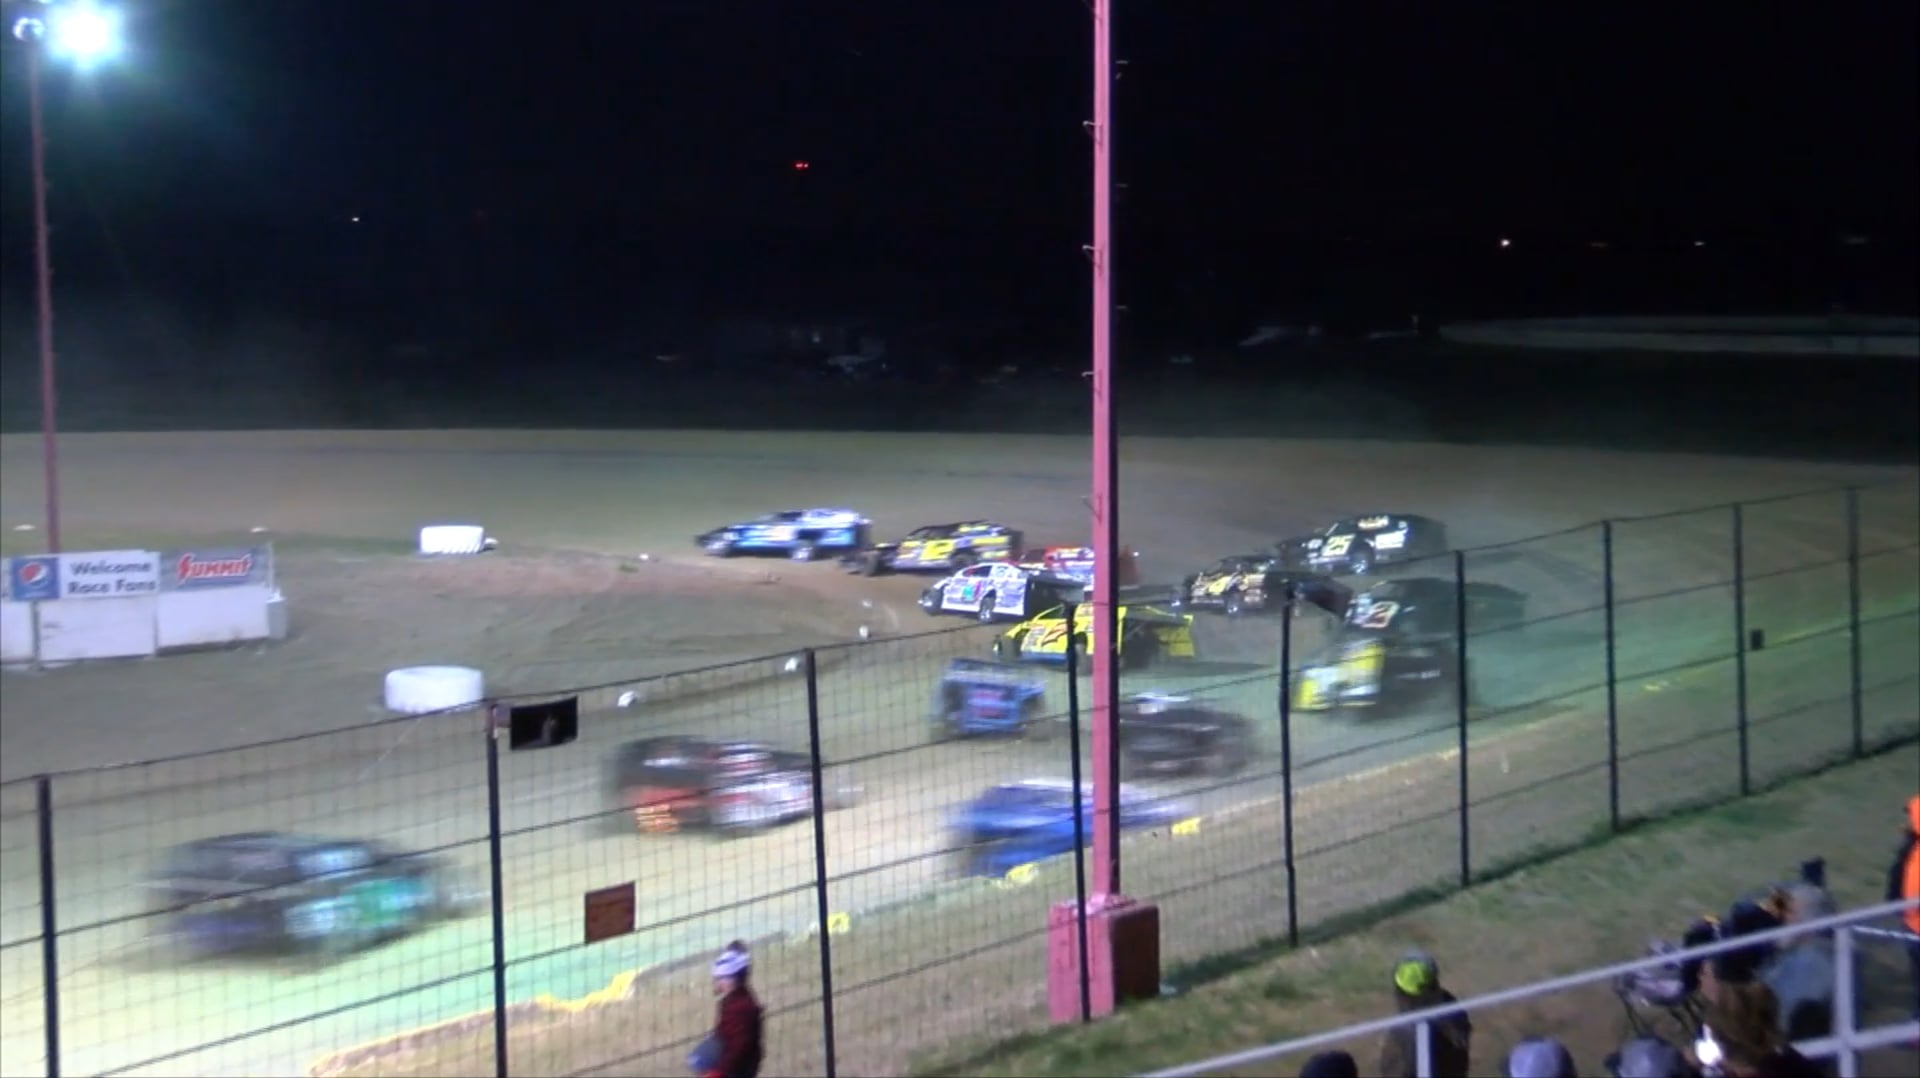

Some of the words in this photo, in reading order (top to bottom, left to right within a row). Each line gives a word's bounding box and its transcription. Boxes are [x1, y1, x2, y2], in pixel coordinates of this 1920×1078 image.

[1321, 534, 1355, 557] 25
[70, 560, 152, 577] Welcome
[67, 581, 110, 596] Race
[115, 578, 156, 595] Fans
